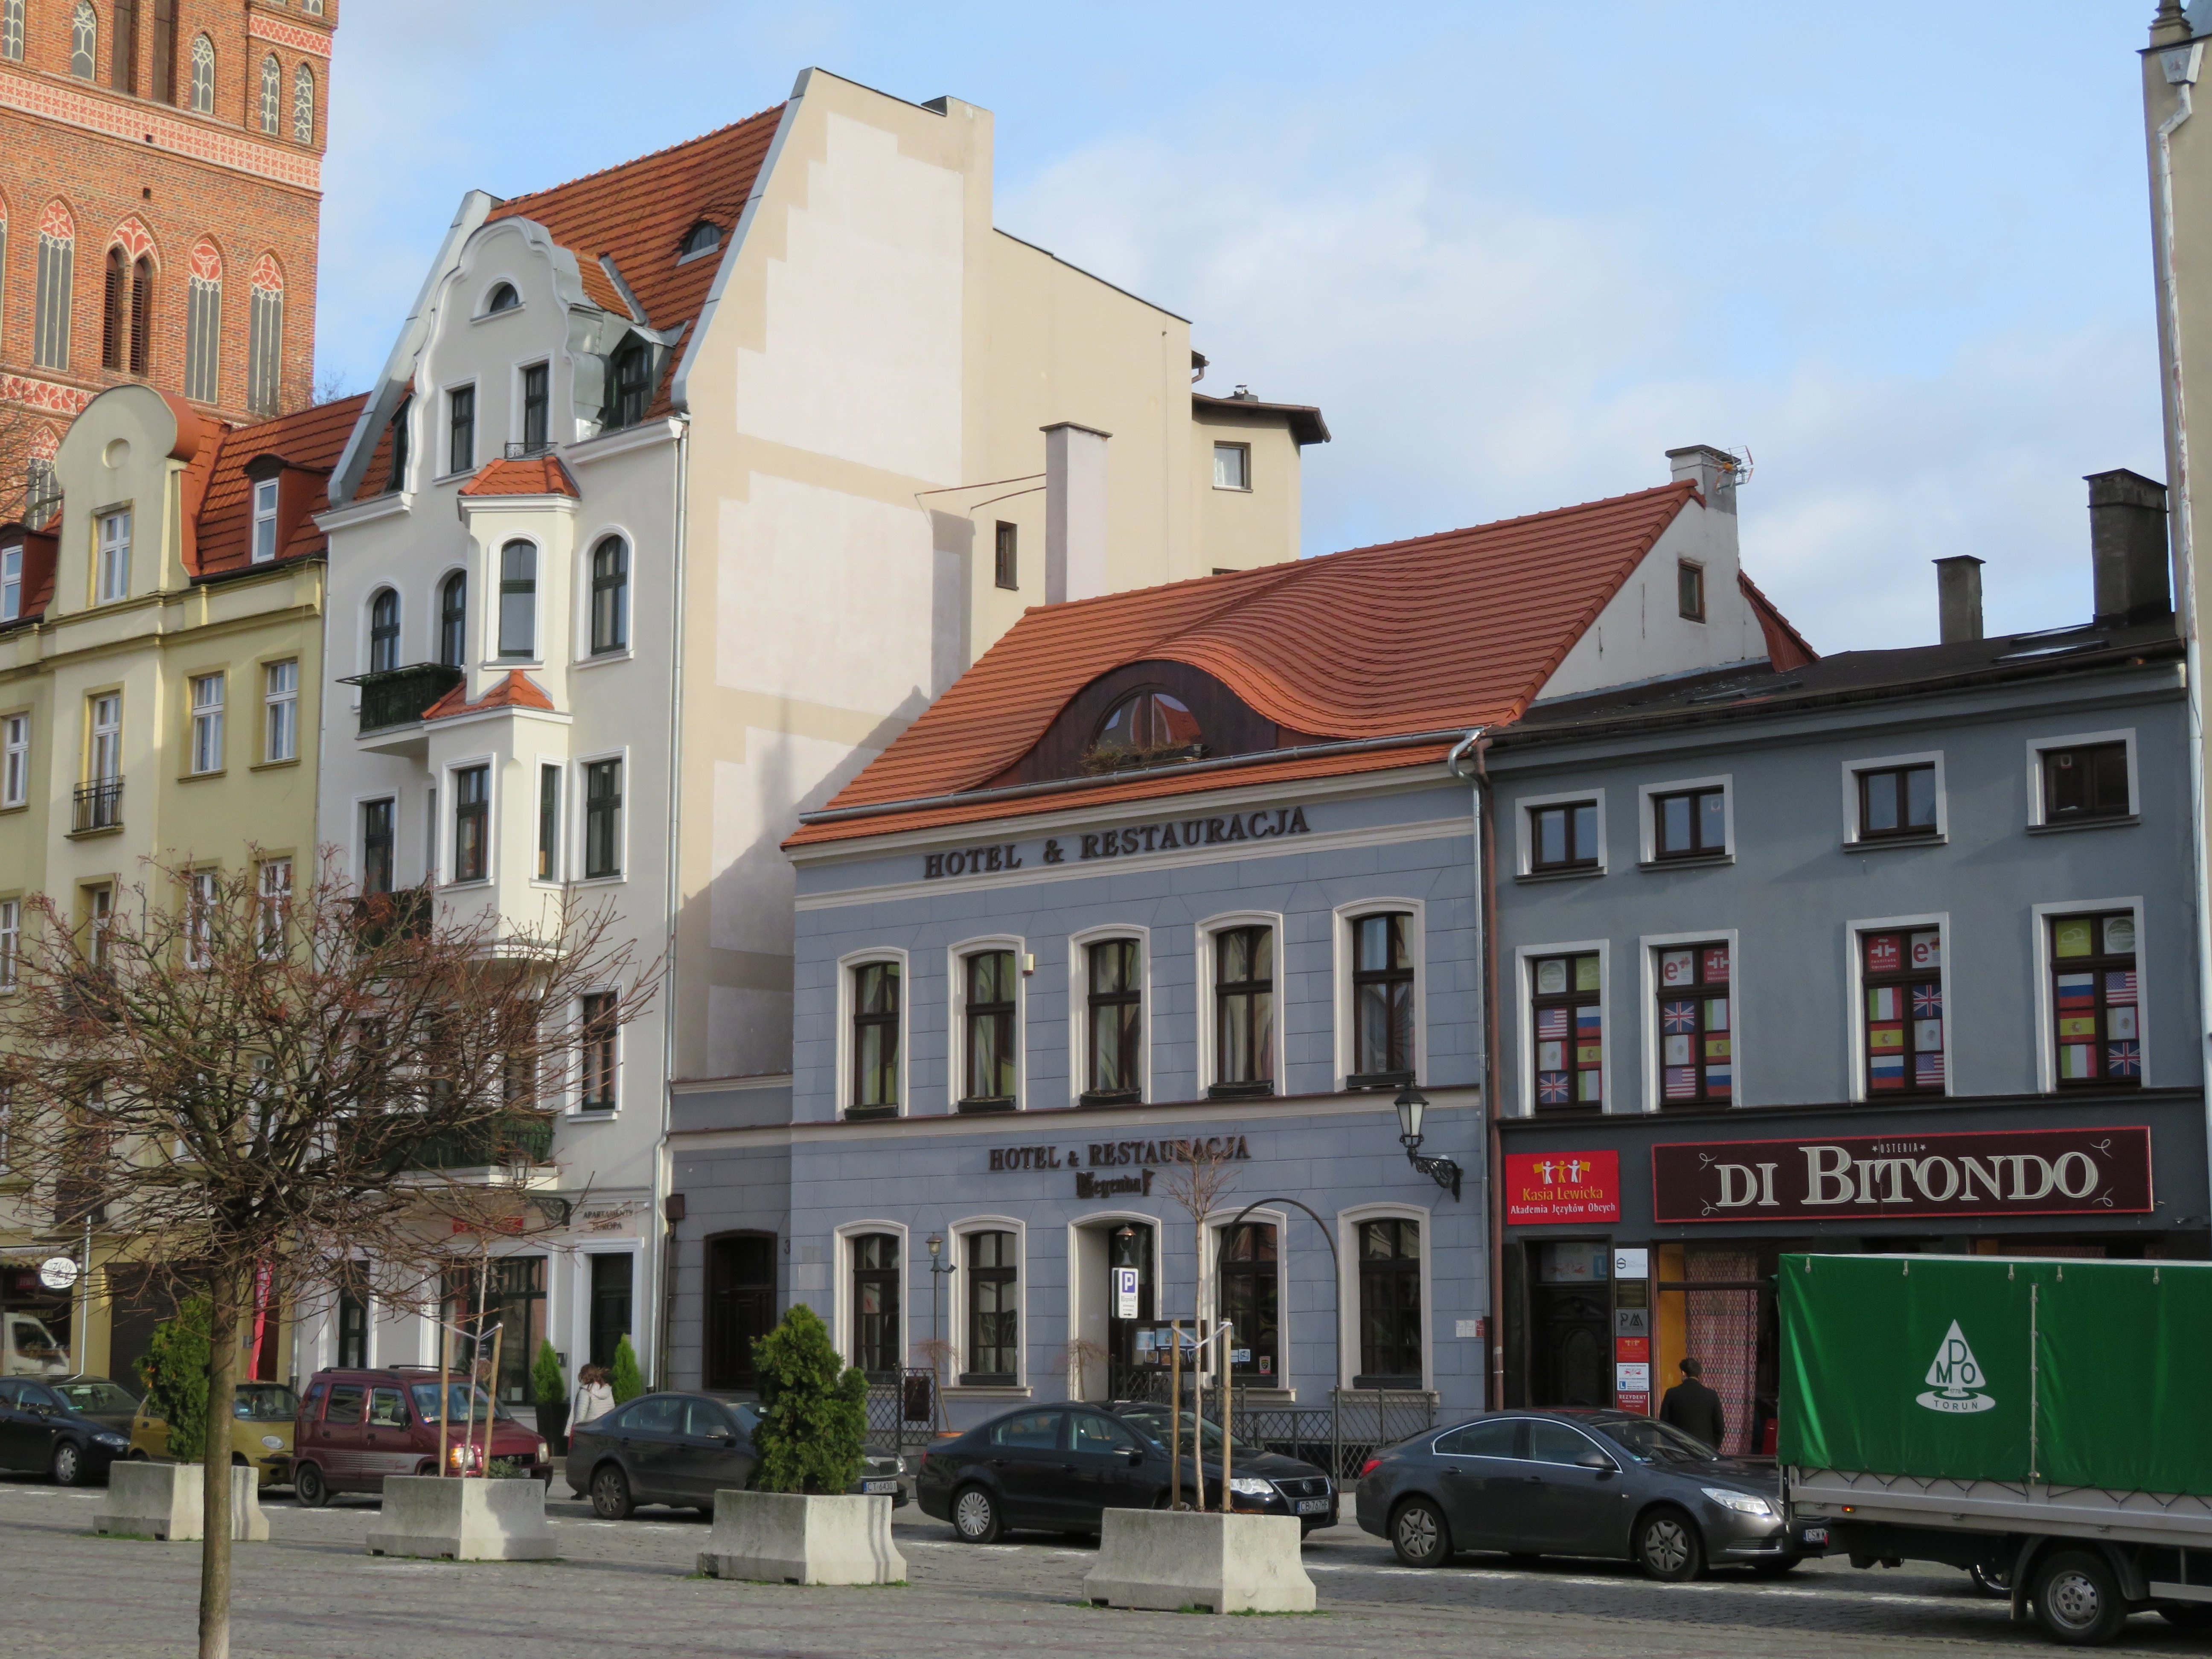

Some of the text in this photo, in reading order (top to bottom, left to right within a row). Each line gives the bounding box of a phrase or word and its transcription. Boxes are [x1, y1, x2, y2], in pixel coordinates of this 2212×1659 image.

[923, 806, 1310, 879] HOTEL & RESTAURACJA
[989, 1135, 1252, 1171] HOTEL & RESTAURACJA
[1880, 1143, 1918, 1153] OSTERIA
[1714, 1145, 2098, 1207] DI BITONDO
[1522, 1186, 1603, 1201] Kasia Lewicka
[1511, 1202, 1615, 1215] Akademia Języków Obcych
[1124, 1273, 1134, 1291] P
[868, 1482, 876, 1491] CT
[1301, 1502, 1310, 1511] CB
